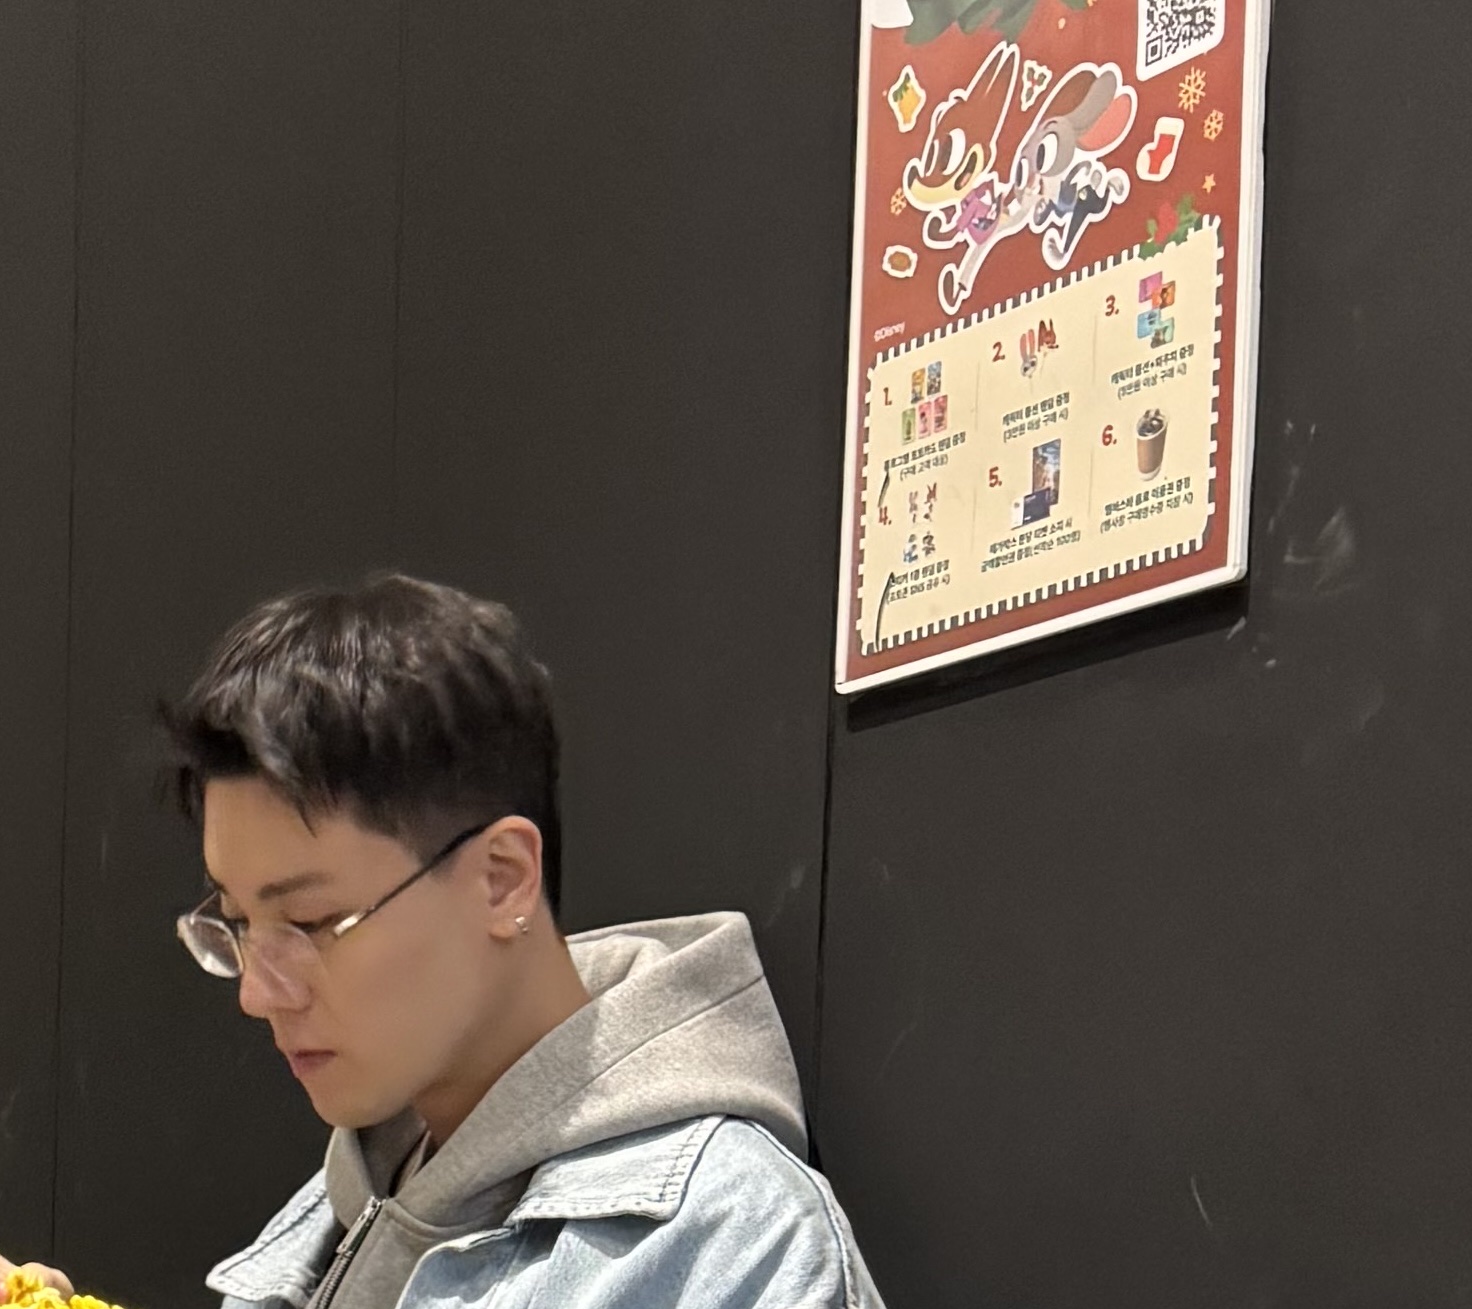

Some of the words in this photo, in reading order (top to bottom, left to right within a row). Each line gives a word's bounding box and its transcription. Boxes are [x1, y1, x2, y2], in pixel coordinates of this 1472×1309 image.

[1105, 295, 1120, 316] 3.
[992, 341, 1006, 362] 2.
[1102, 424, 1118, 446] 6.
[988, 466, 1003, 488] 5.
[878, 506, 892, 526] 4.
